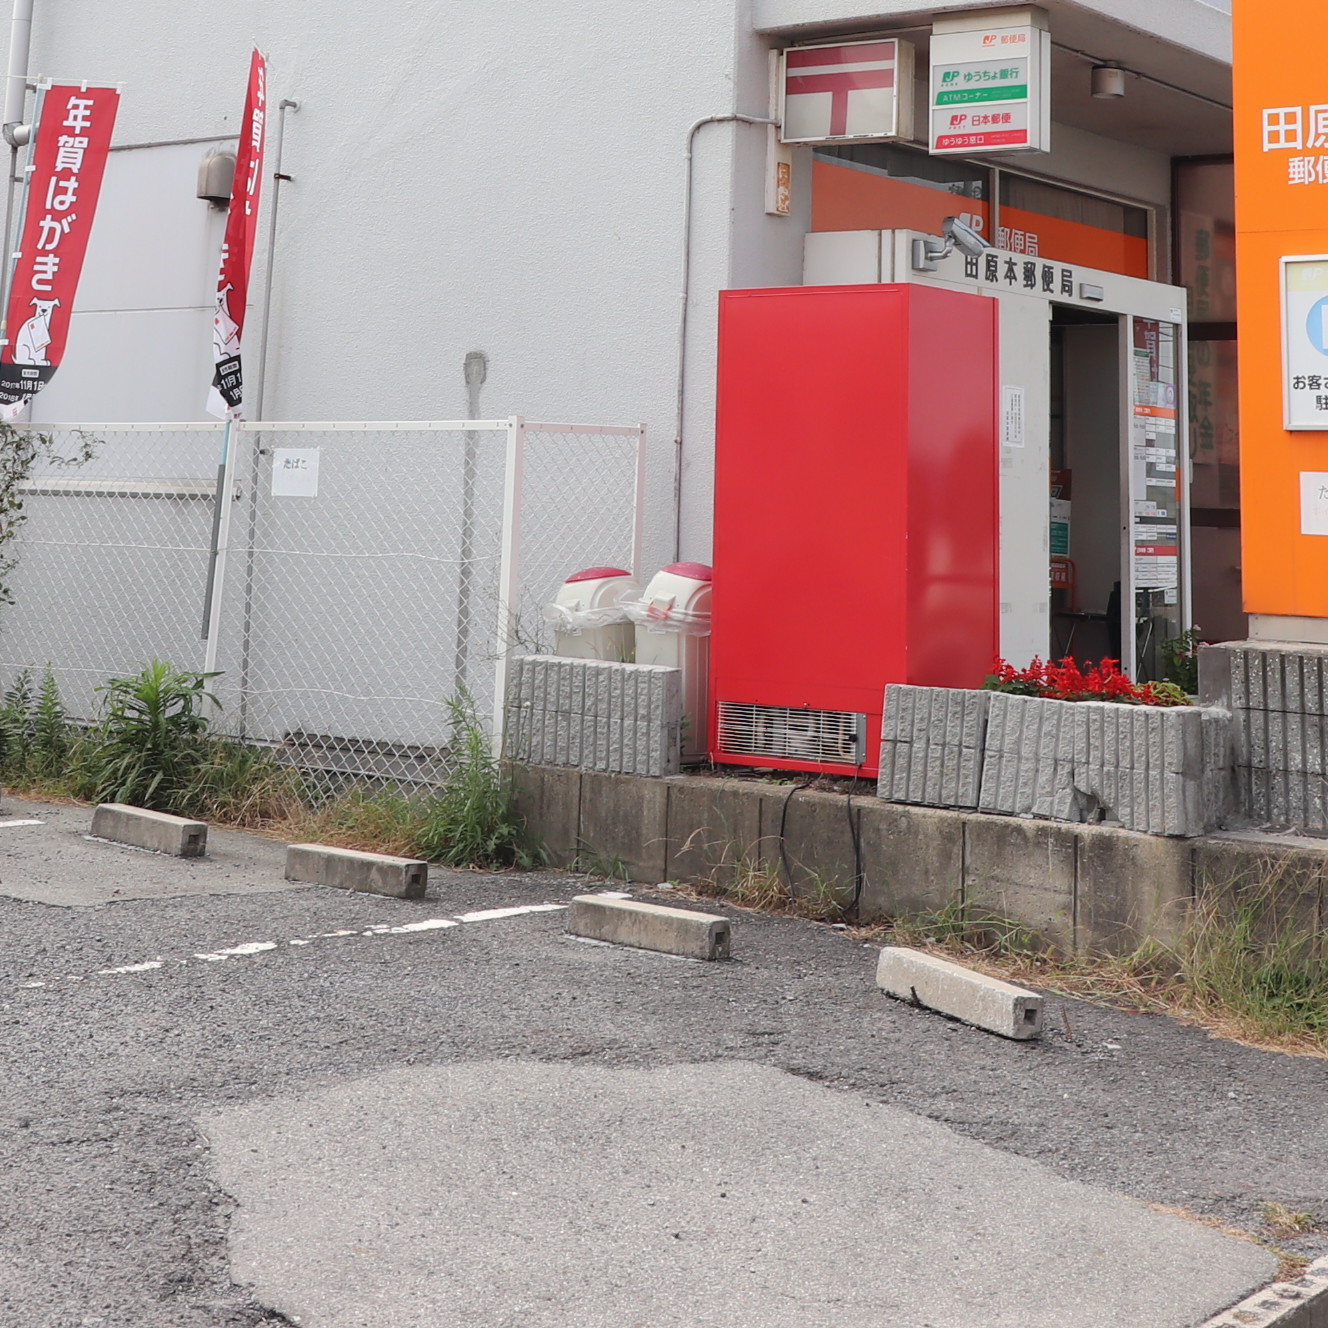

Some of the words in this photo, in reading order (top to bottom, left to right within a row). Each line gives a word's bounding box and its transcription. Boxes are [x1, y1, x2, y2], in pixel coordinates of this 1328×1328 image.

[1001, 33, 1026, 45] 郵便局
[964, 67, 1020, 83] ゆうちょ銀行
[972, 112, 1012, 127] 日本郵便
[942, 135, 985, 146] ゆうゆう窓口
[31, 96, 94, 292] 年賀はがき
[965, 253, 1073, 298] 田原本郵便局
